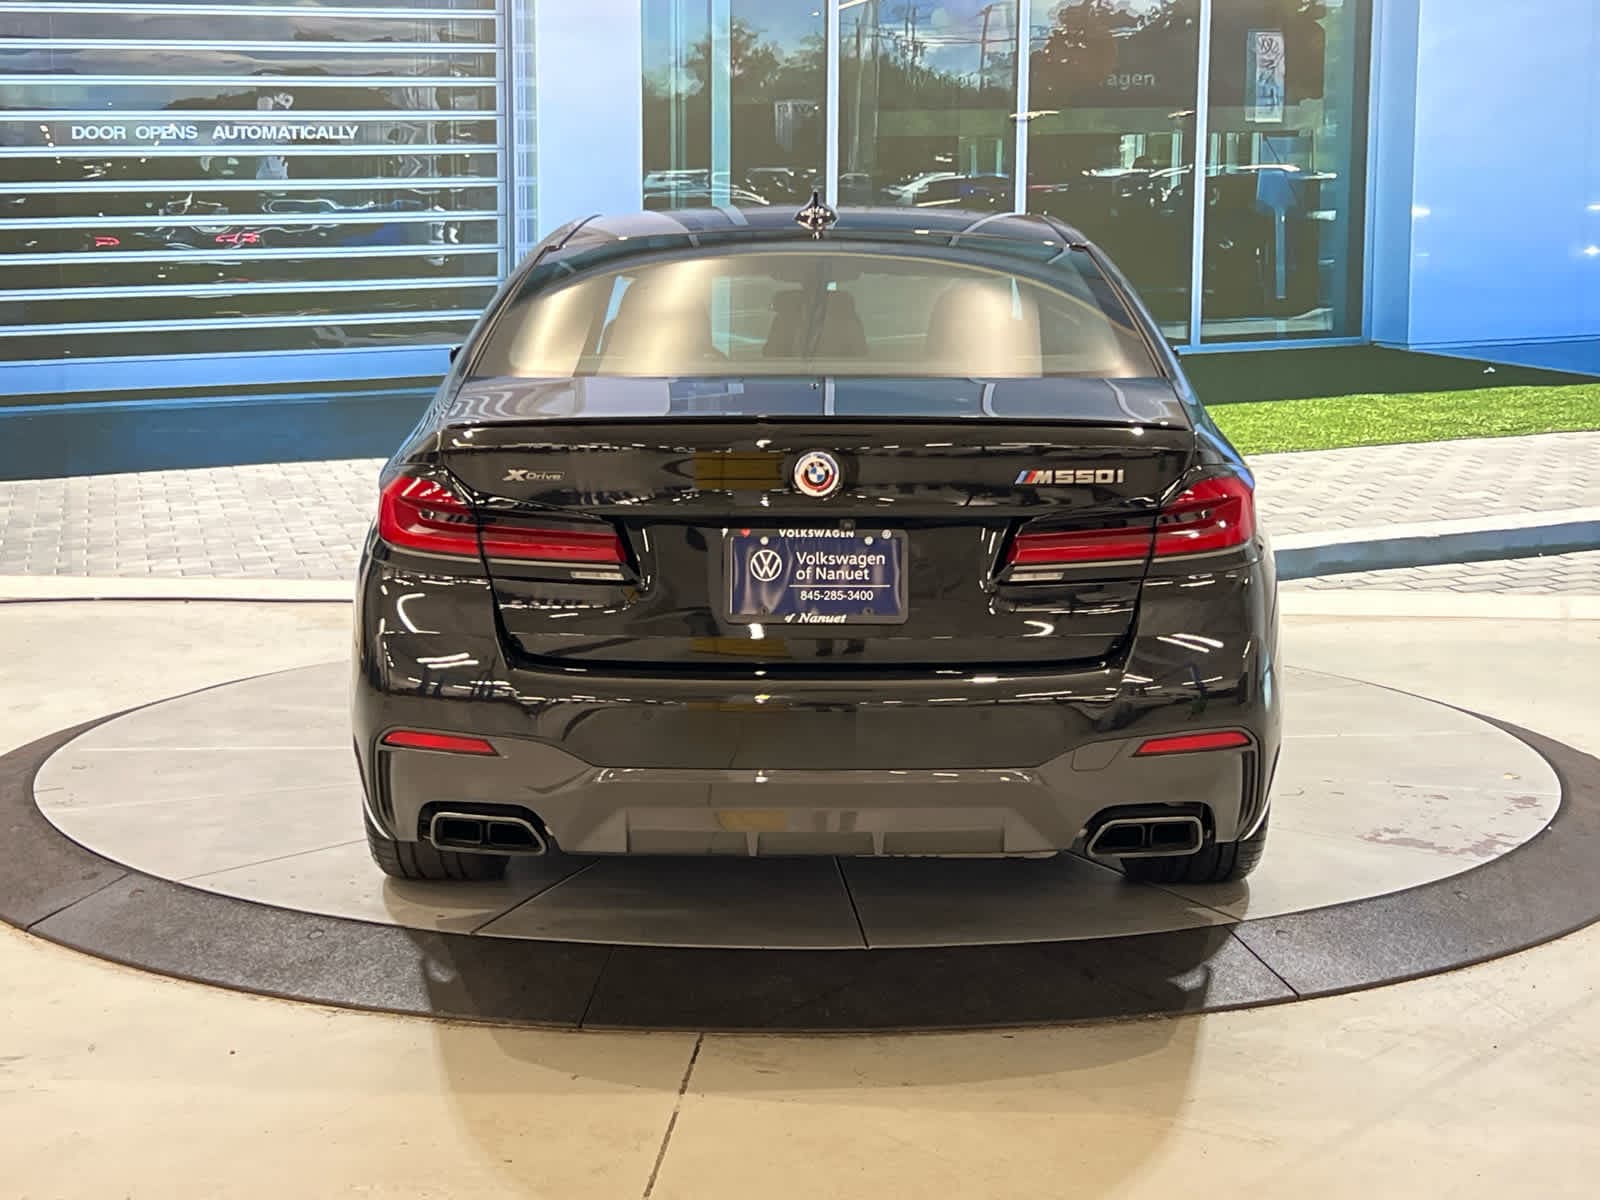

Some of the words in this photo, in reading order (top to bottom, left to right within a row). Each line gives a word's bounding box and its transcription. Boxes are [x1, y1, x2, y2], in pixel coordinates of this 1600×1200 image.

[71, 125, 126, 140] DOOR
[135, 125, 199, 140] OPENS
[212, 125, 359, 140] AUTOMATICALLY
[779, 529, 855, 538] VOLKSWAGEN
[796, 552, 885, 568] Volkswagen
[796, 567, 812, 580] of
[815, 567, 870, 580] Nanuet
[800, 590, 874, 601] 845-285-3400
[798, 612, 848, 624] Nanuet
